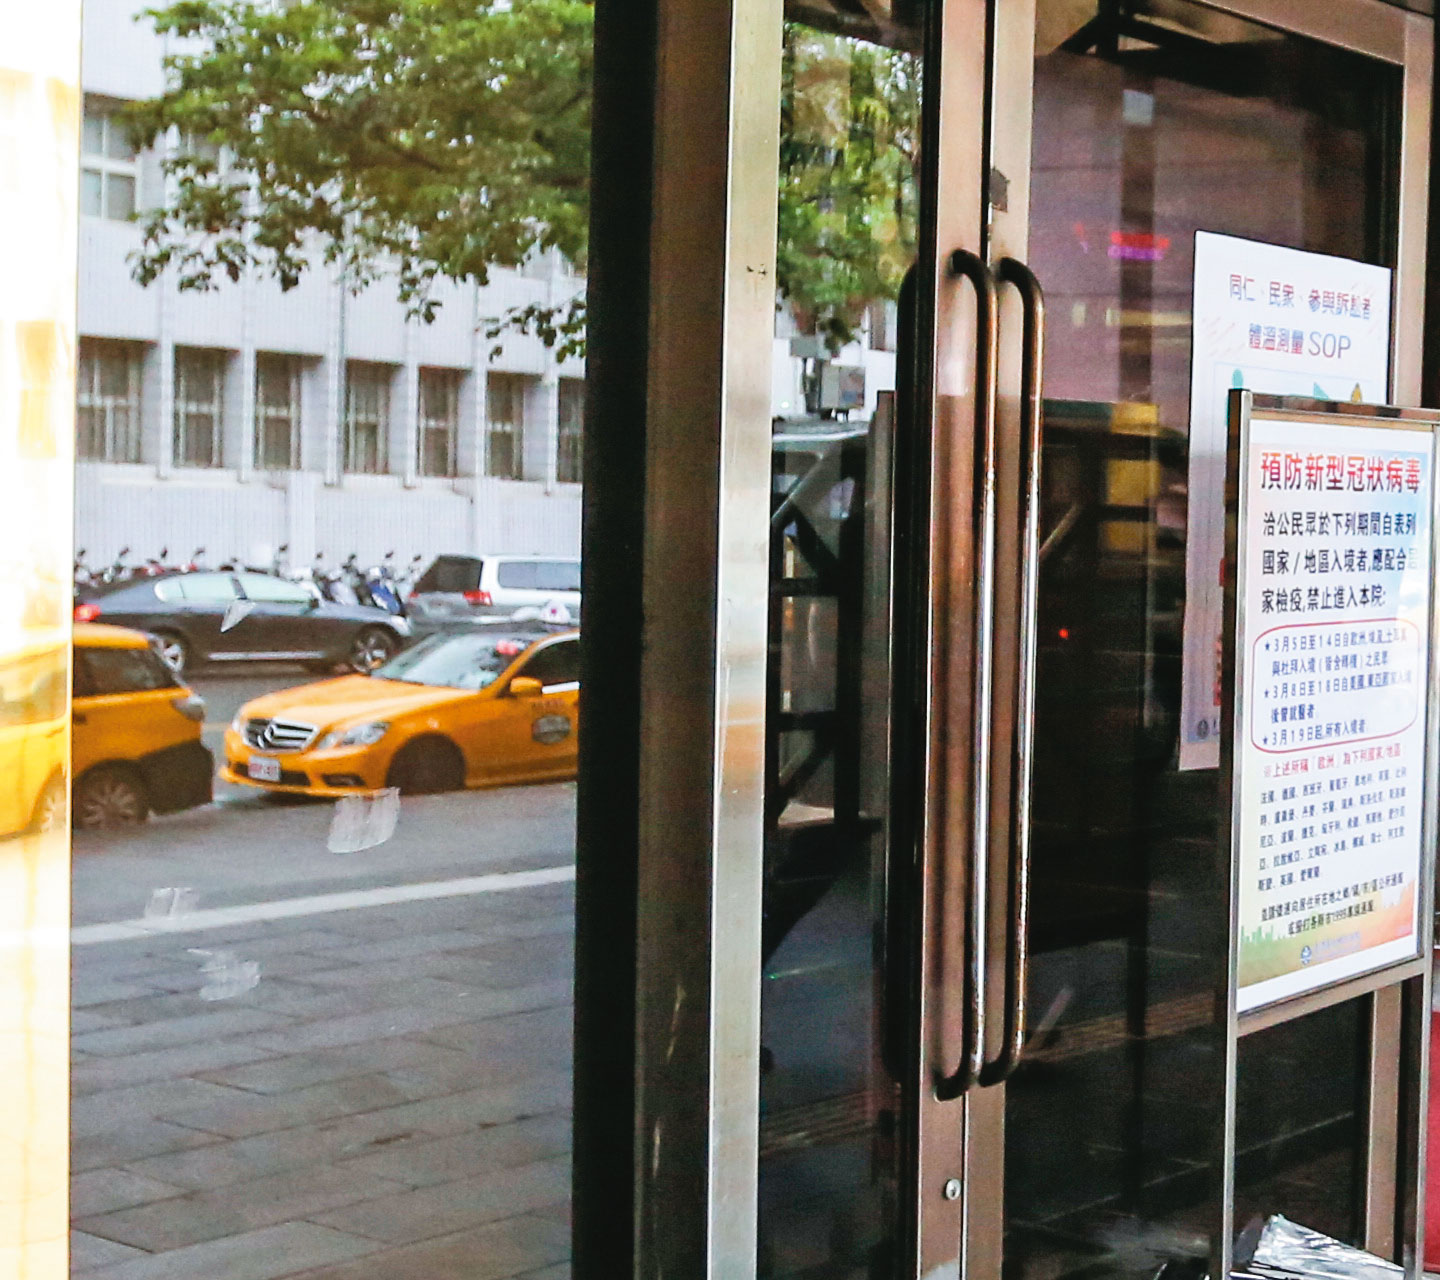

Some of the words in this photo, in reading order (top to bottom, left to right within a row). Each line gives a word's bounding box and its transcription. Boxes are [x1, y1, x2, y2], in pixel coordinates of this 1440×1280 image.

[1308, 331, 1351, 359] SOP
[1260, 452, 1421, 494] 預防新型冠狀病毒
[1263, 511, 1417, 536] 洽公民眾於下列期間自表列
